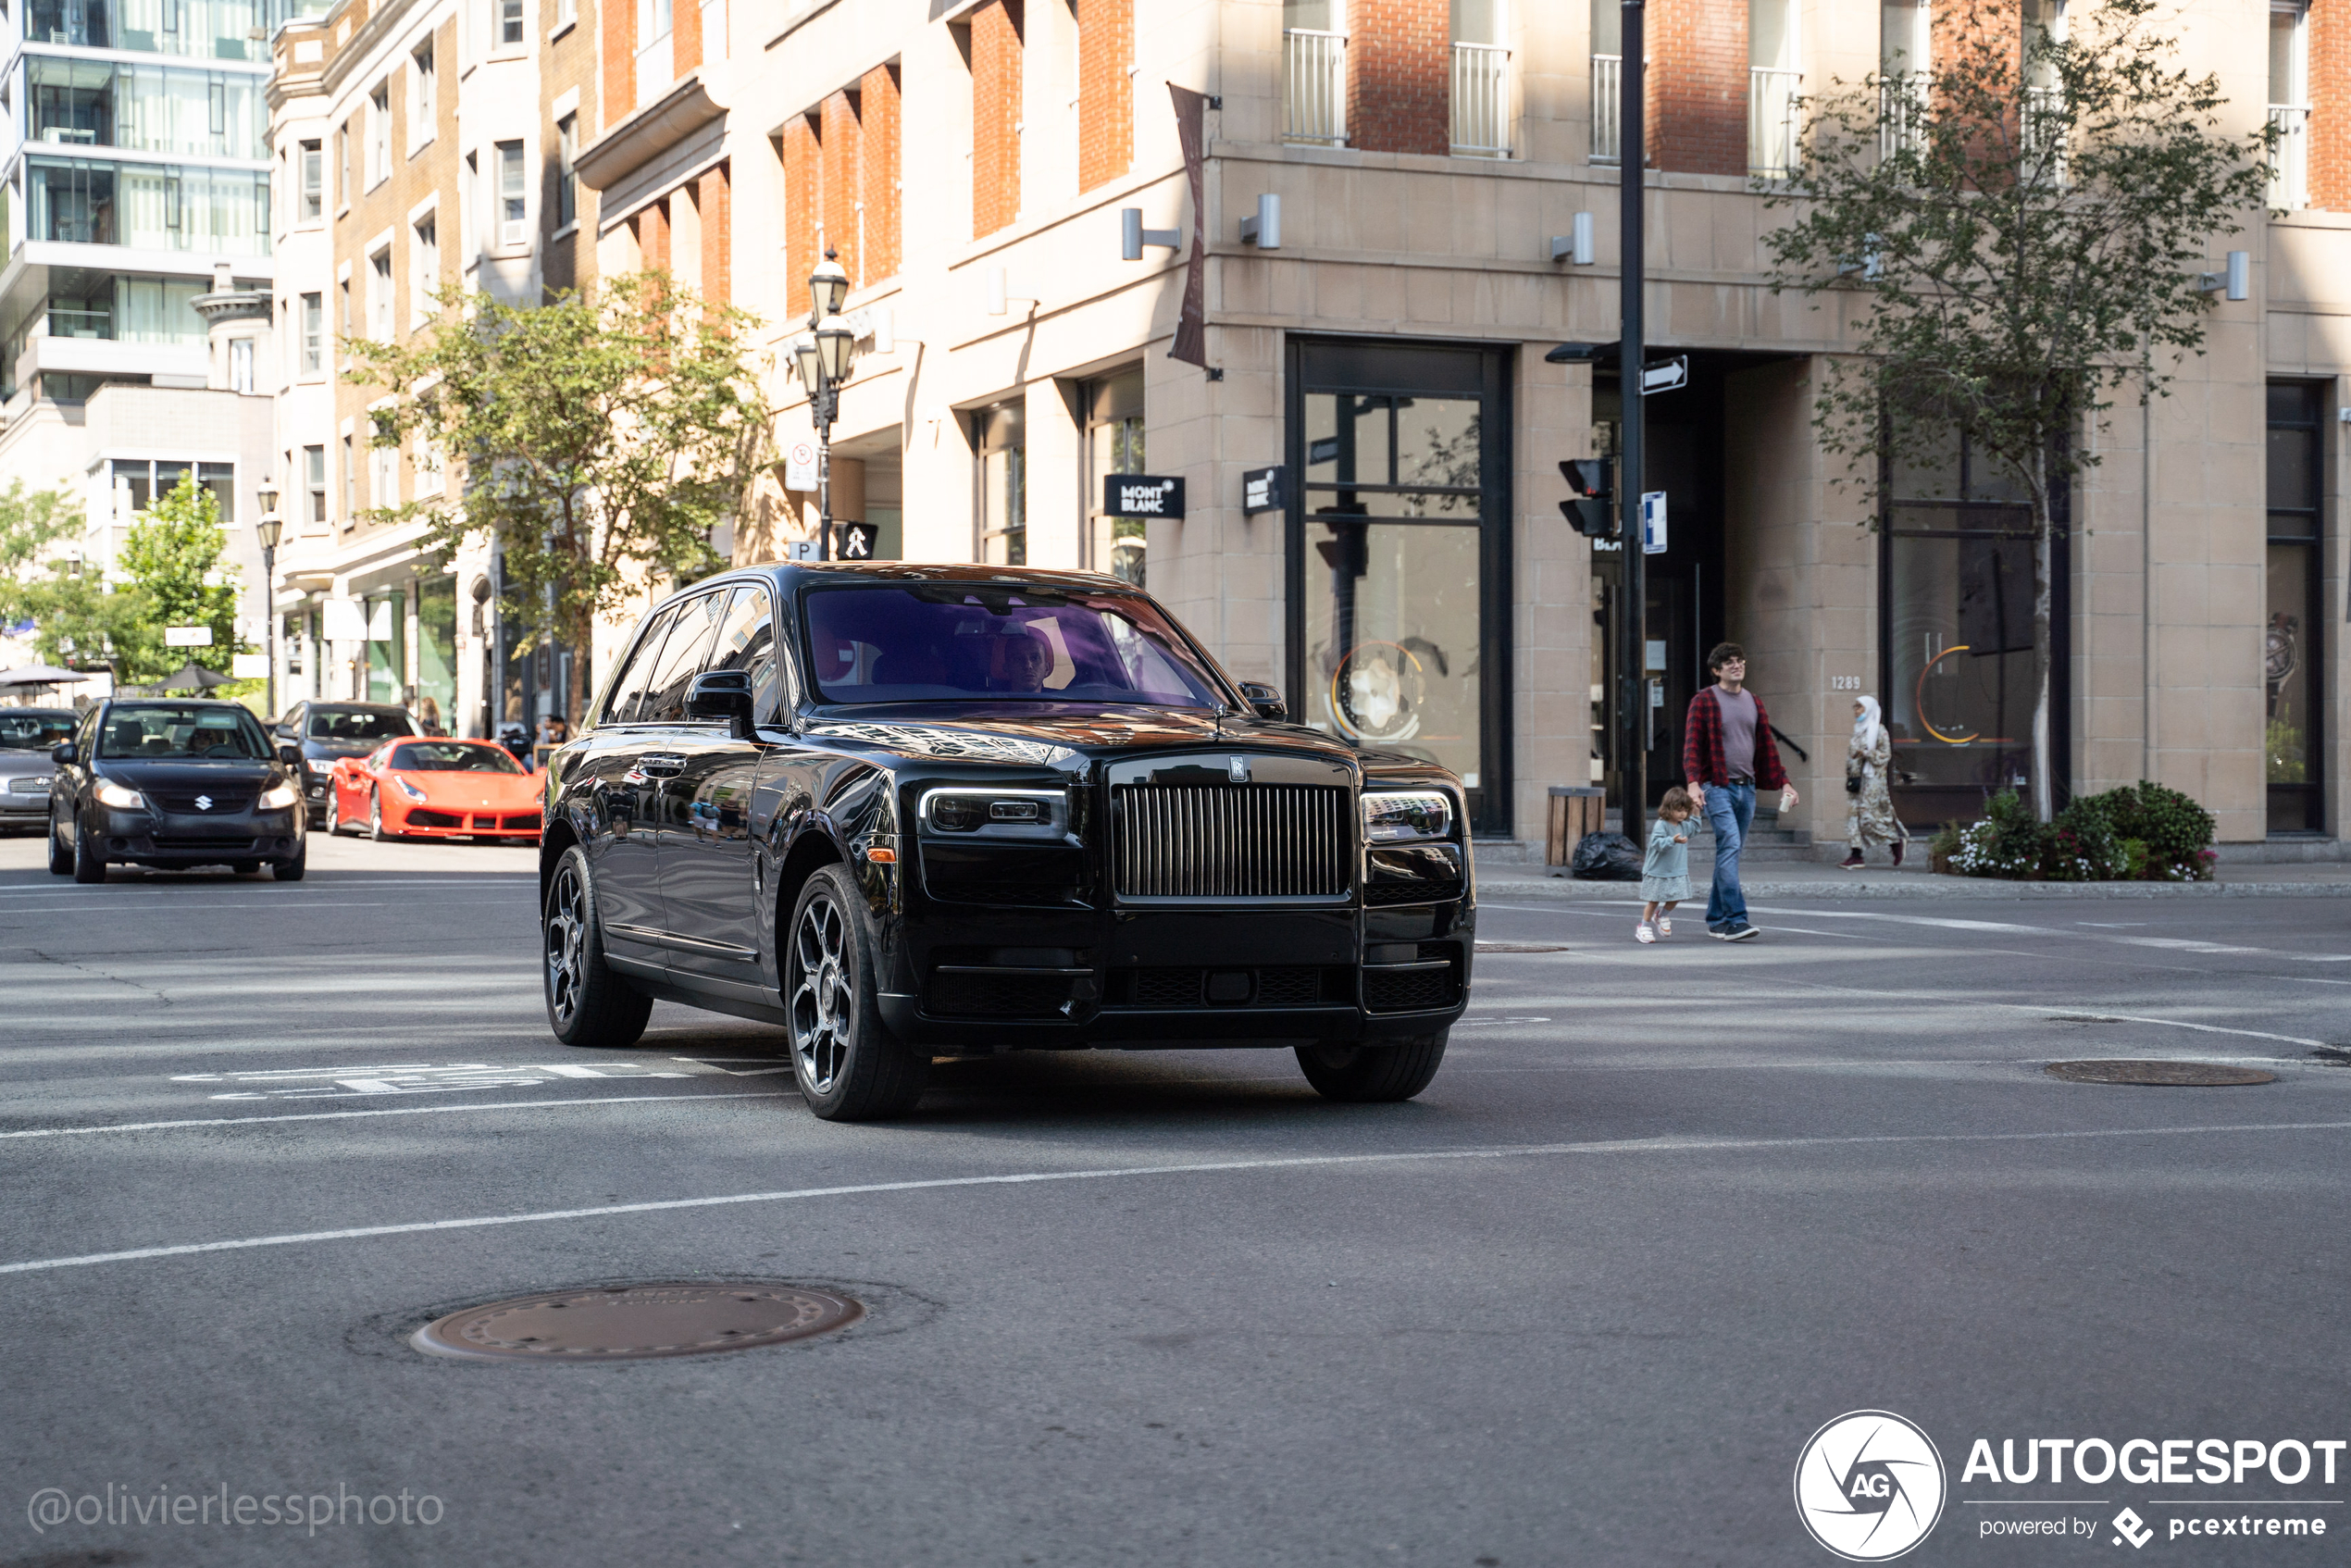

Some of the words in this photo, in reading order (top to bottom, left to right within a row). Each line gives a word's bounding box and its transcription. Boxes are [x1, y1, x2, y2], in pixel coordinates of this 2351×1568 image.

[1121, 485, 1163, 500] MONT
[1121, 498, 1163, 513] BLANC
[1832, 676, 1860, 690] 1289
